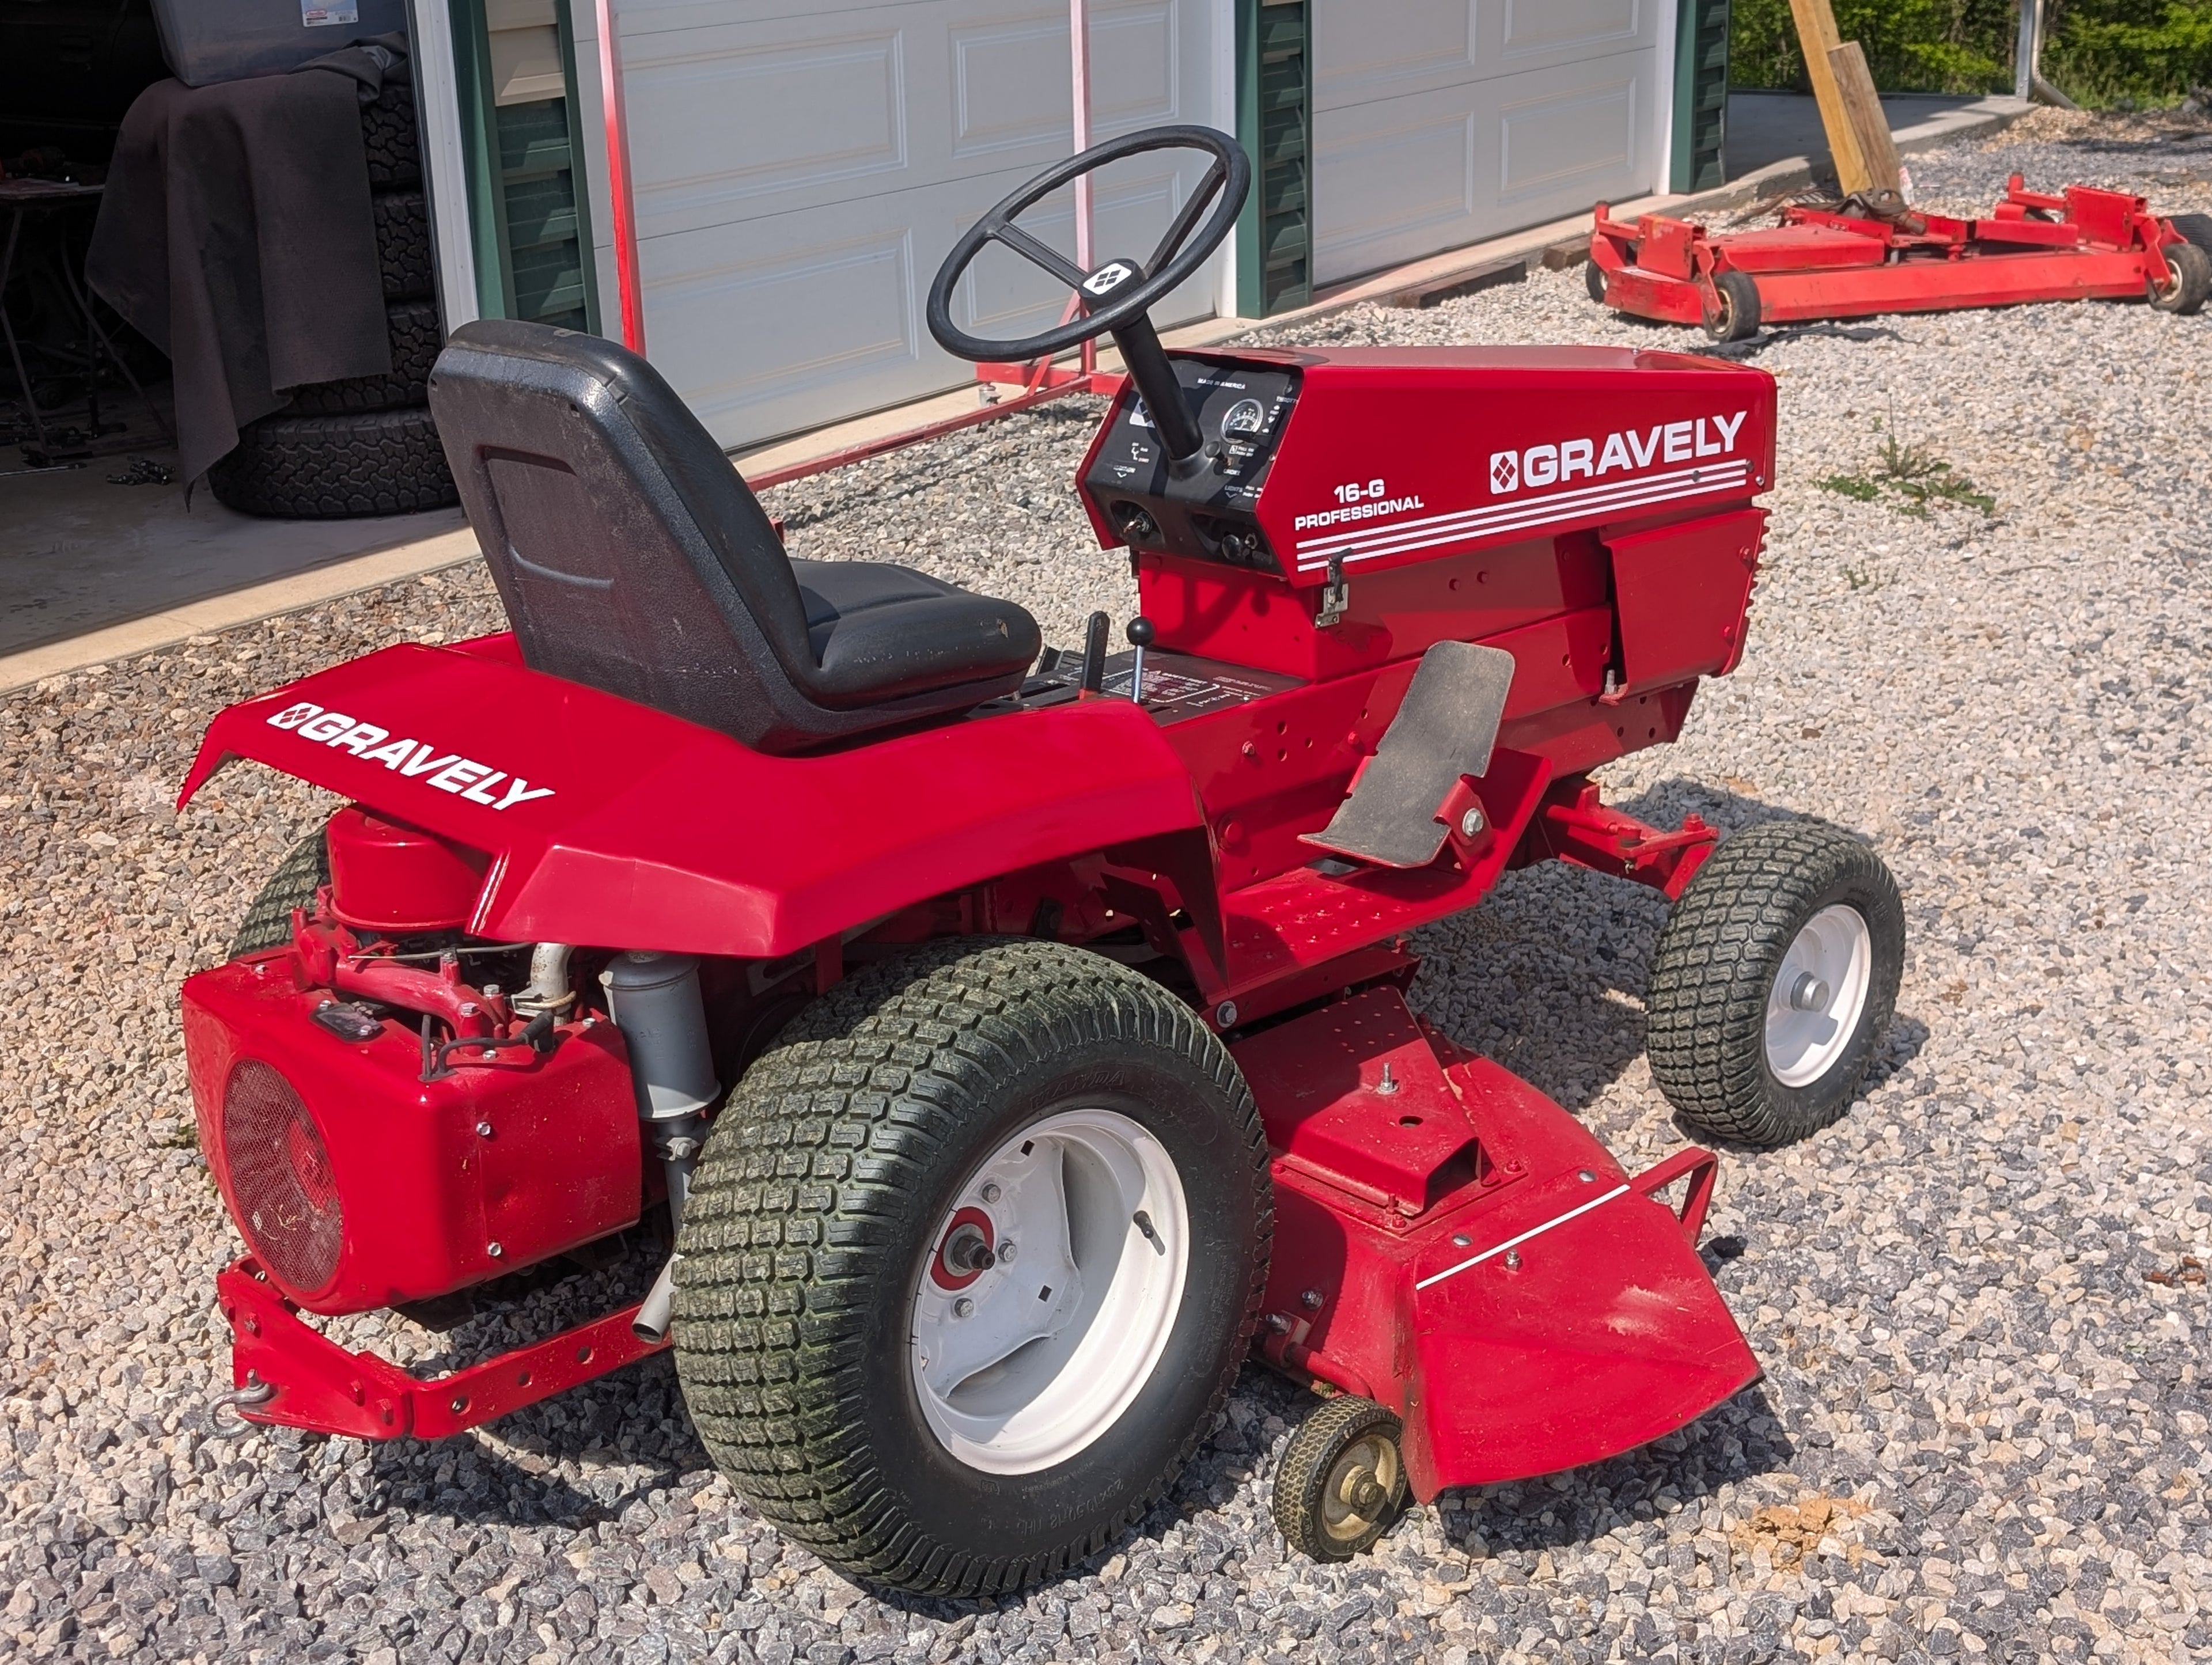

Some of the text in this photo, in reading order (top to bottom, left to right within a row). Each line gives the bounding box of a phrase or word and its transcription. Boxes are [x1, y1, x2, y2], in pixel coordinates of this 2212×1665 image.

[1219, 381, 1246, 390] AMERICA
[1524, 411, 1748, 488] GRAVELY
[1334, 479, 1385, 504] 16-G
[1294, 495, 1425, 531] PROFESSIONAL
[297, 712, 556, 811] GRAVELY
